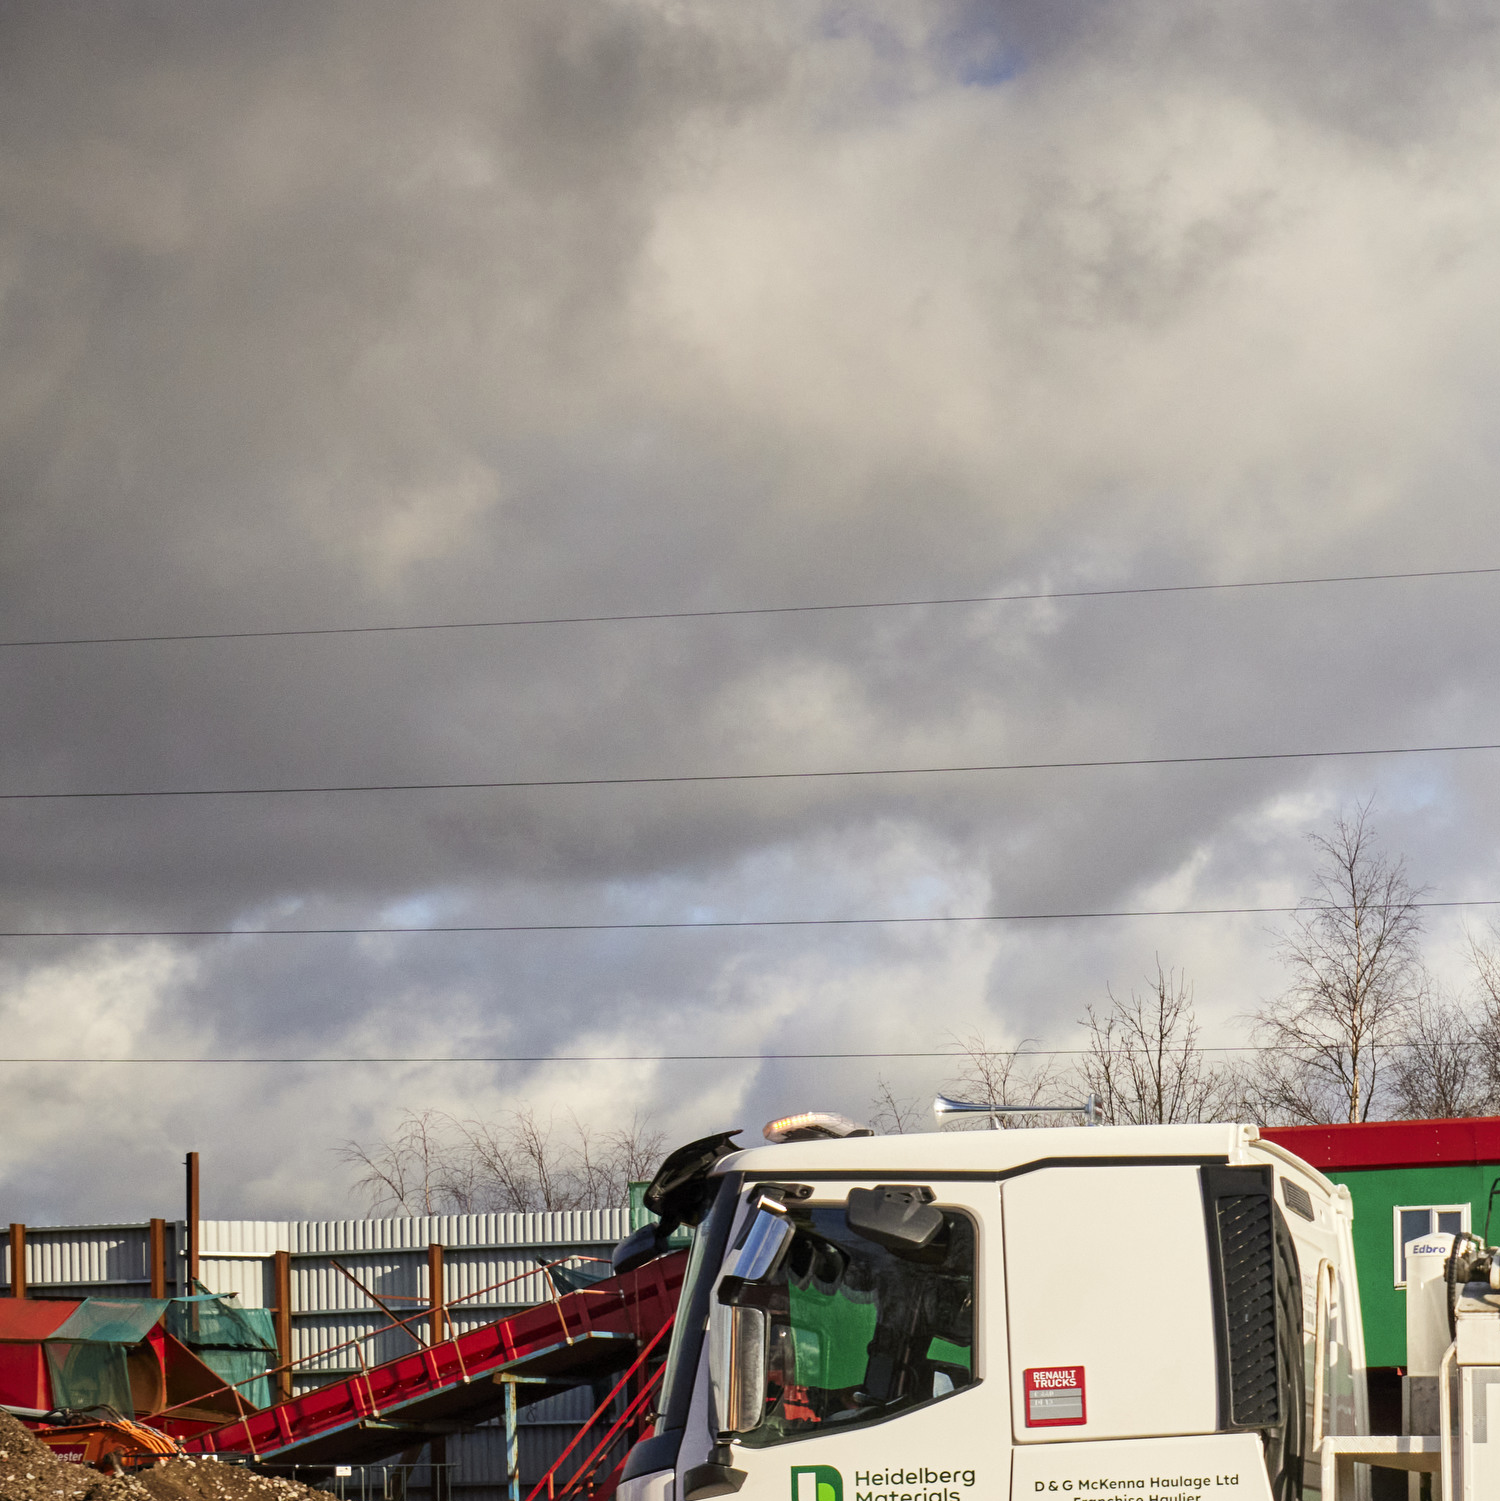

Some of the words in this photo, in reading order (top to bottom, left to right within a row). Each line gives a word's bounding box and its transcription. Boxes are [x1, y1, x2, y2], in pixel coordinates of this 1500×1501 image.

[1413, 1244, 1446, 1254] Edbro
[1033, 1370, 1076, 1380] RENAULT
[1034, 1378, 1077, 1388] TRUCKS
[855, 1467, 975, 1487] Heidelberg
[1035, 1481, 1045, 1492] D
[1048, 1480, 1059, 1491] &
[1062, 1479, 1073, 1491] G
[1078, 1478, 1145, 1491] McKenna
[1150, 1475, 1211, 1489] Haulage
[1216, 1474, 1239, 1486] Ltd
